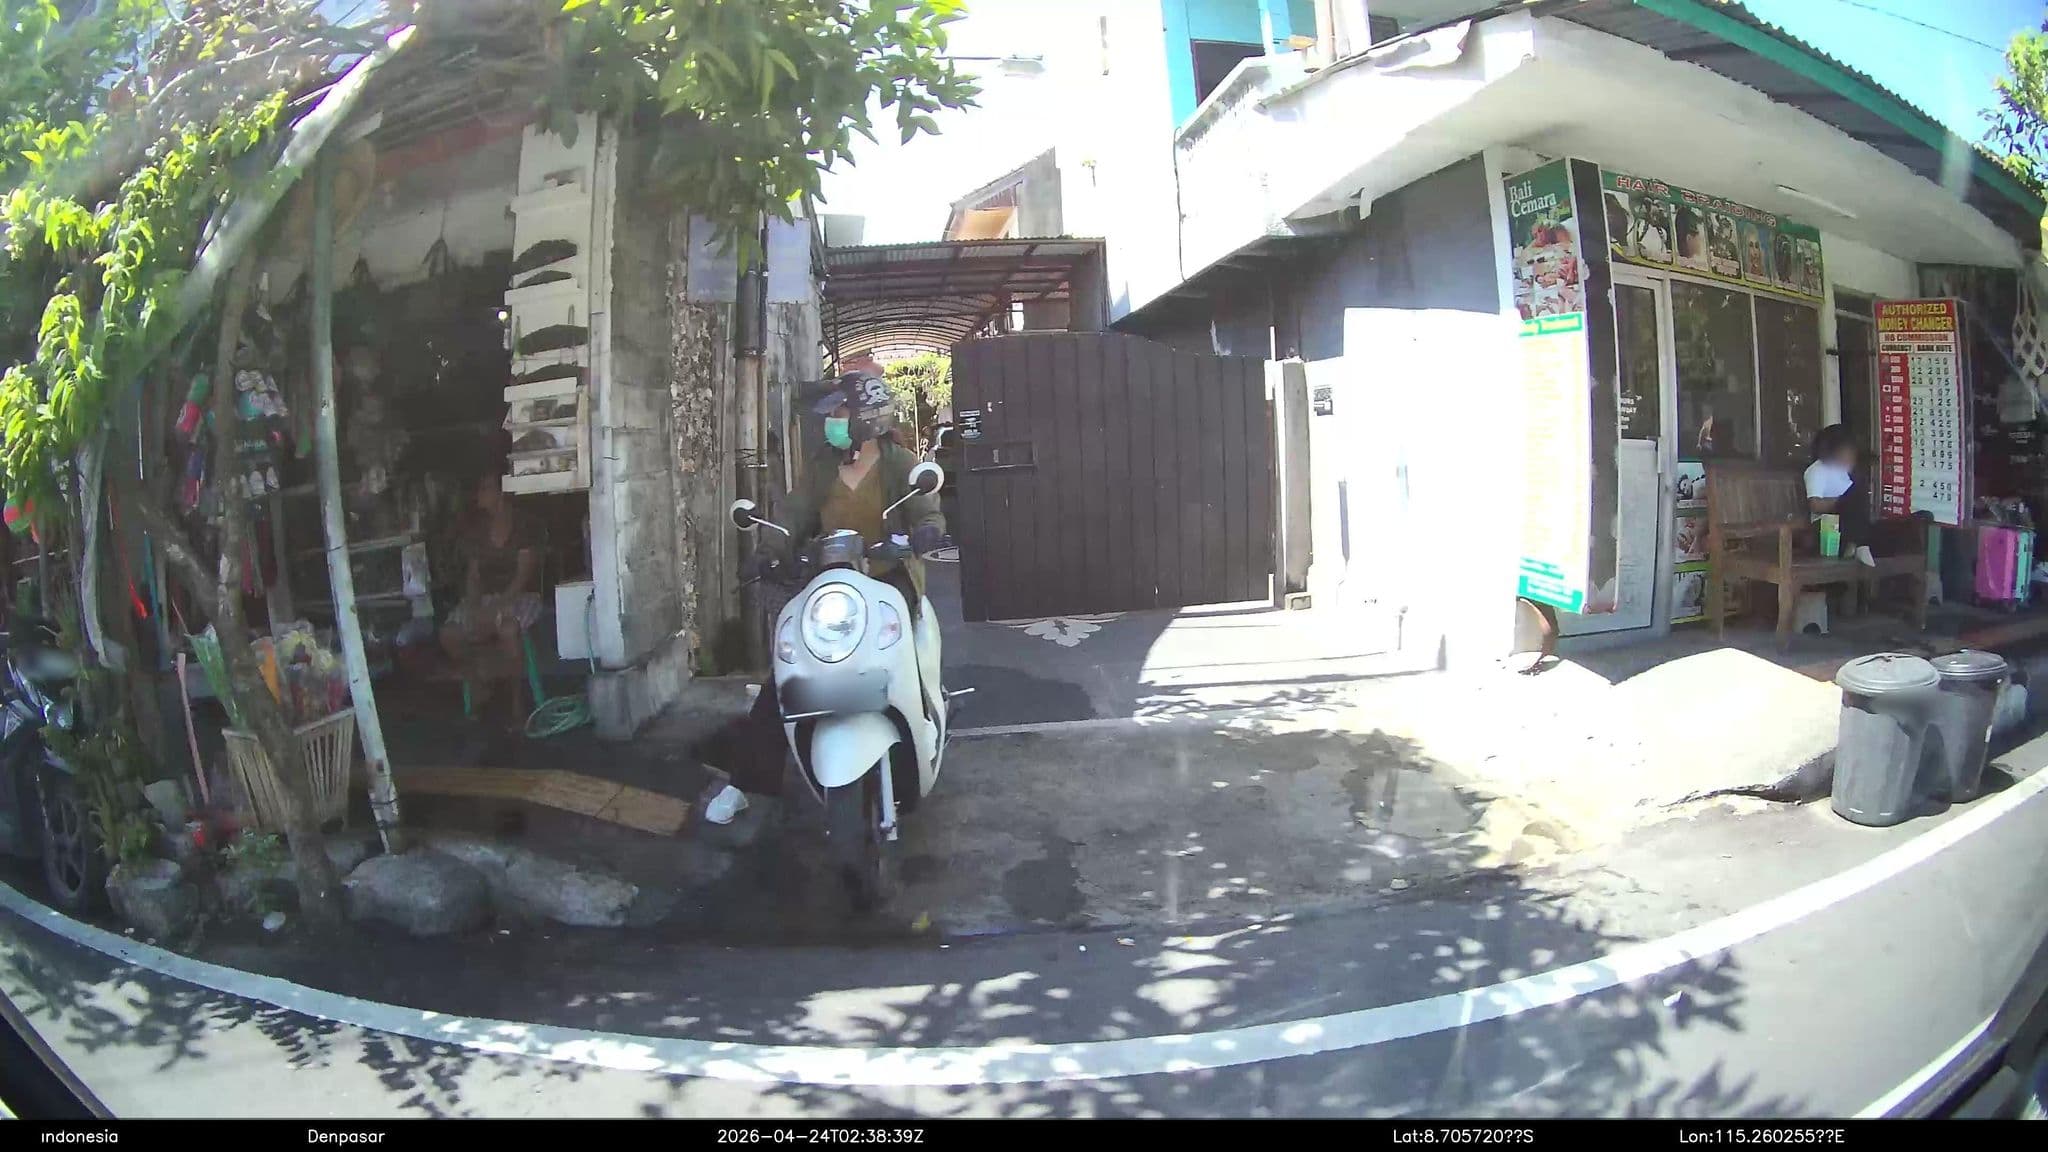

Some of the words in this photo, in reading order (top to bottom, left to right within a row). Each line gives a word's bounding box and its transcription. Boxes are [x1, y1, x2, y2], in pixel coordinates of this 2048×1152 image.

[1509, 180, 1533, 200] Bali
[1510, 193, 1557, 217] Cemara
[1616, 175, 1672, 198] HAIR
[1680, 189, 1777, 228] BRAIDING
[1882, 303, 1947, 316] AUTHORIZED
[1878, 317, 1908, 332] MONEY
[1910, 316, 1954, 331] CHANGER
